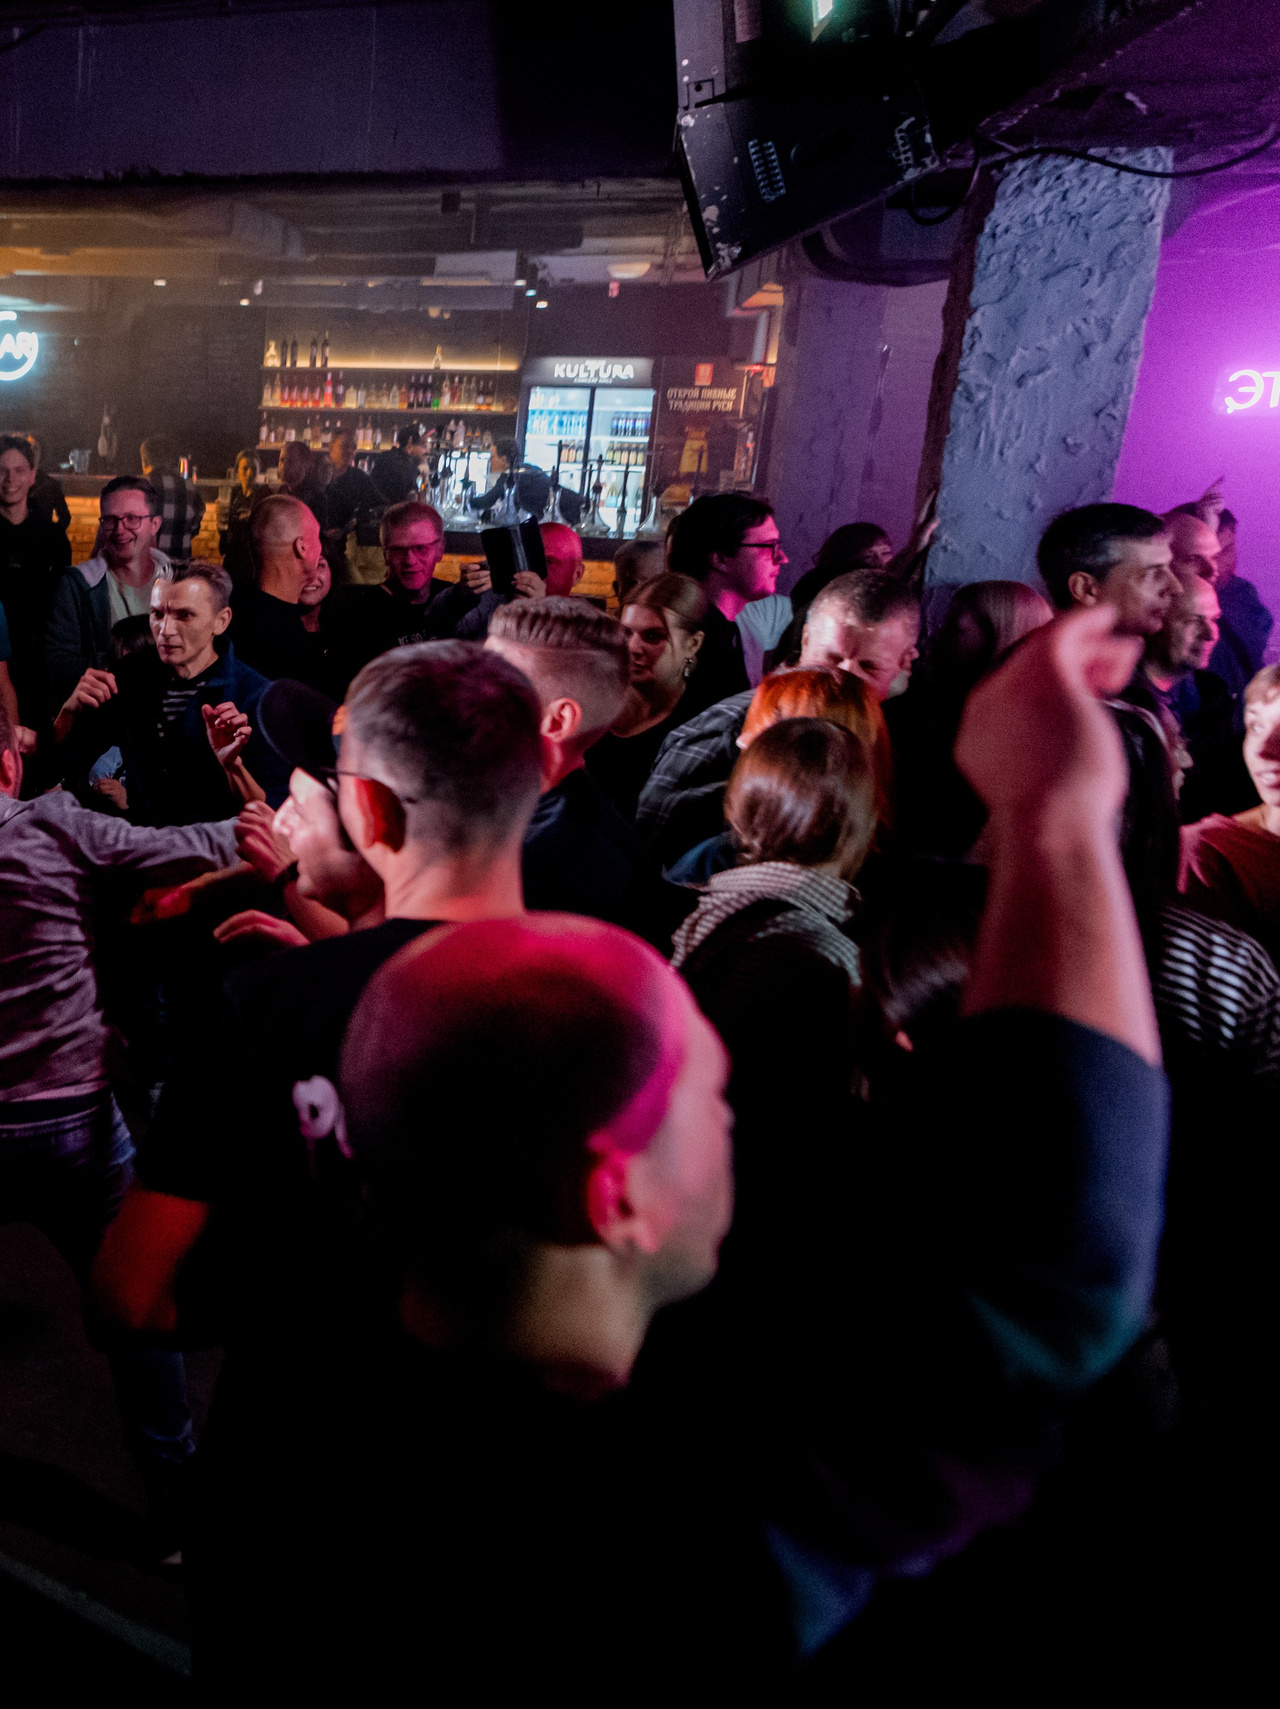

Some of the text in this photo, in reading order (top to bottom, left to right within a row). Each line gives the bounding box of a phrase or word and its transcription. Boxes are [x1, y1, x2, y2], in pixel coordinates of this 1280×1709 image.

[554, 362, 634, 379] KULTURA
[667, 387, 737, 400] ОТКРОЙ ПИВНЫЕ
[669, 400, 733, 412] ТРАДИЦИИ РУСИ
